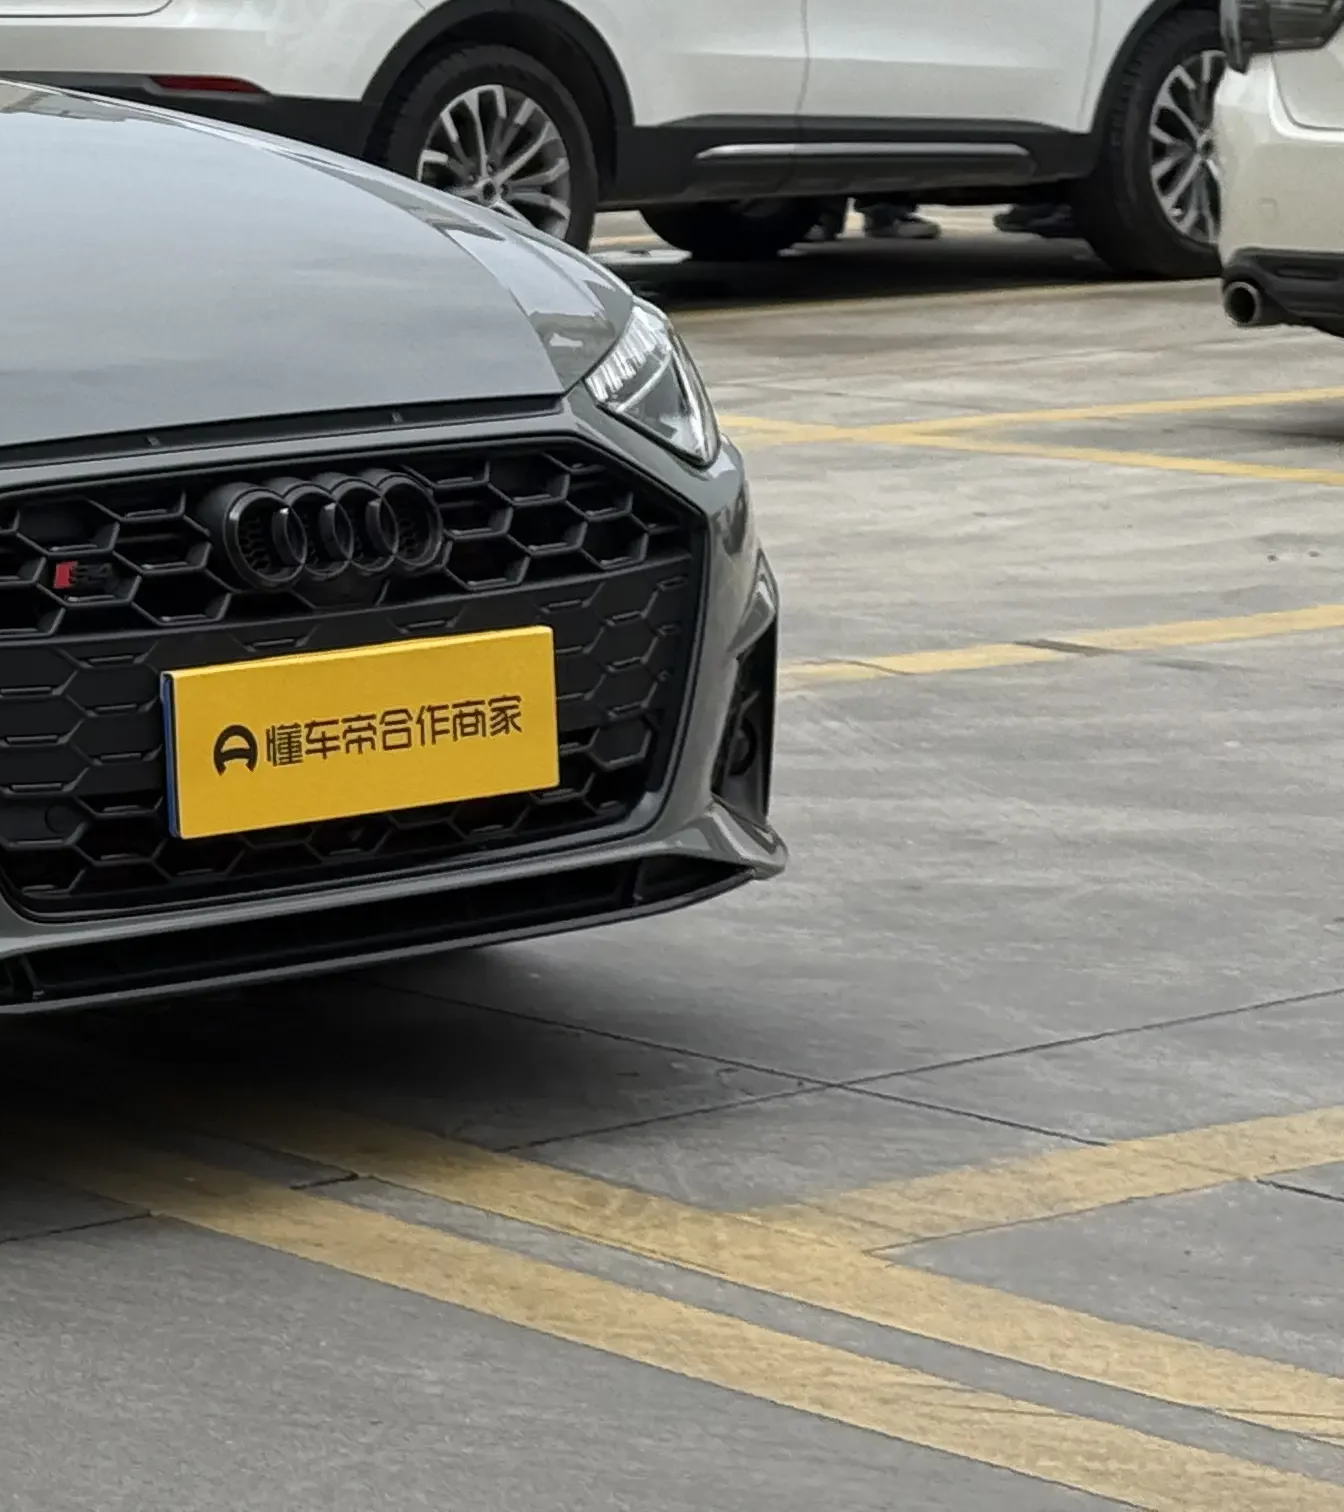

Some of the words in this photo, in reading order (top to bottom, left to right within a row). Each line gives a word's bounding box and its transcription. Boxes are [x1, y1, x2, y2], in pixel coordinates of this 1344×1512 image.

[265, 694, 523, 768] 懂车帝合作商家
